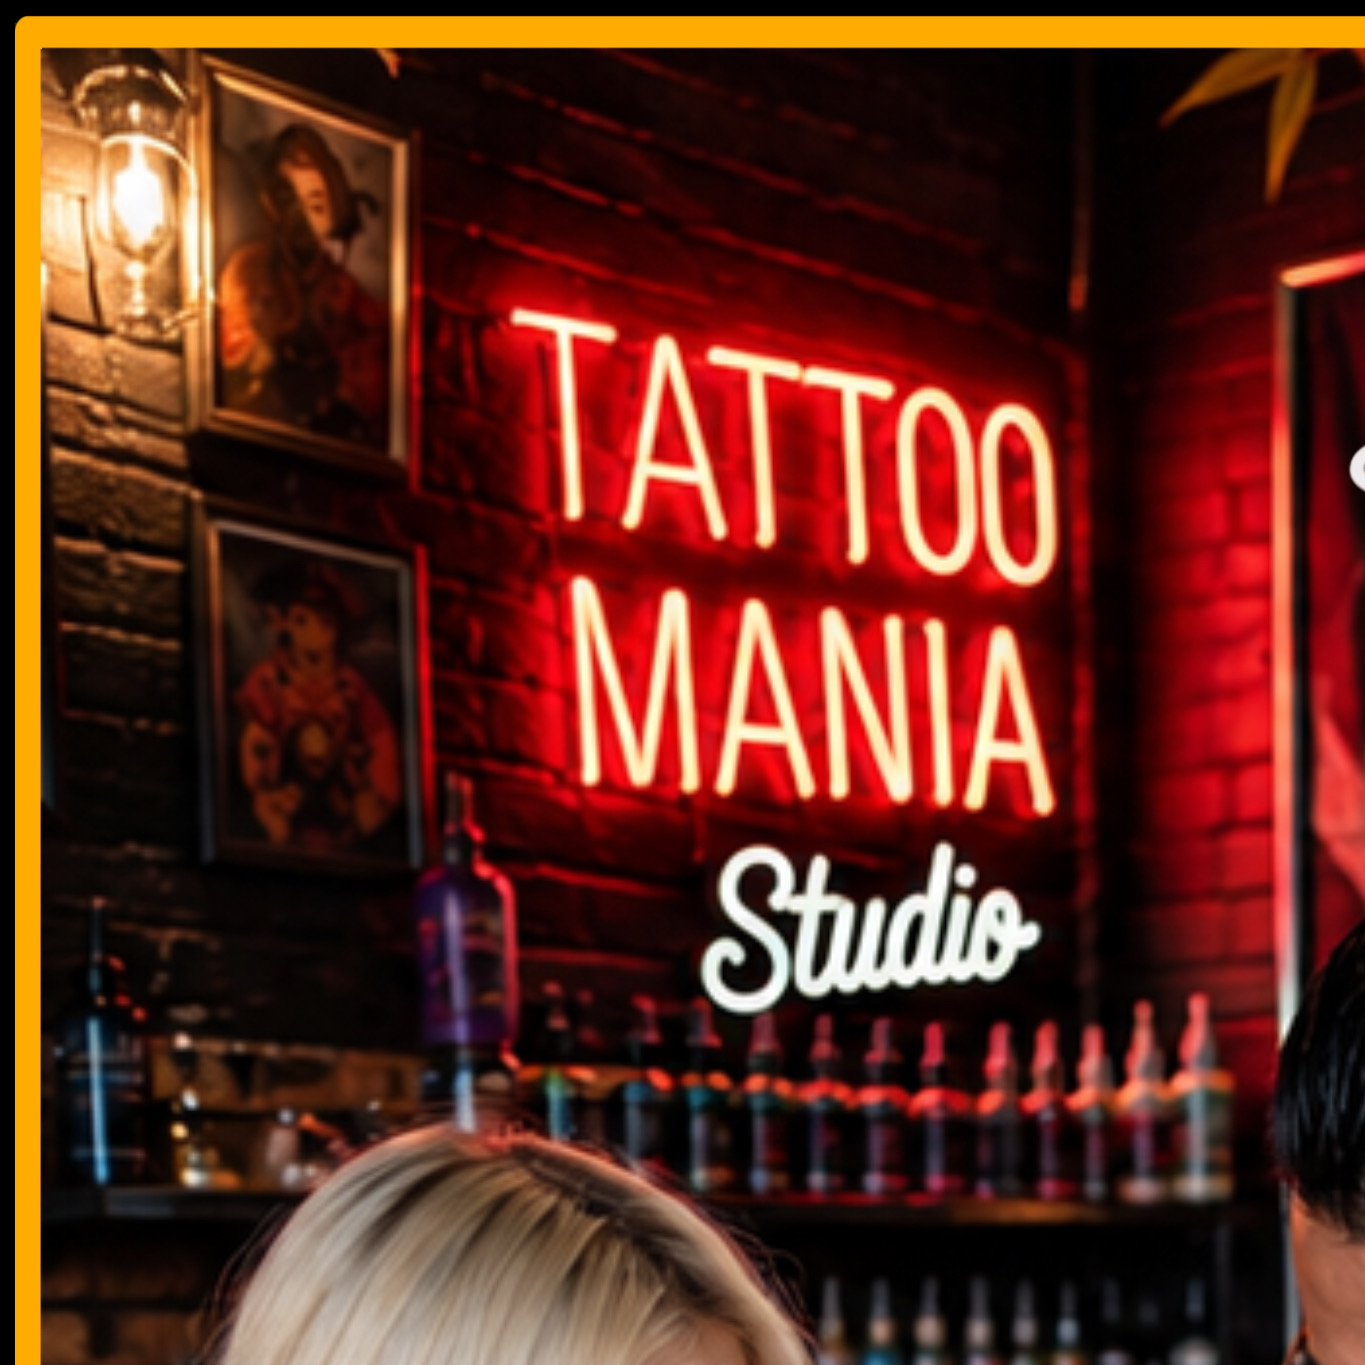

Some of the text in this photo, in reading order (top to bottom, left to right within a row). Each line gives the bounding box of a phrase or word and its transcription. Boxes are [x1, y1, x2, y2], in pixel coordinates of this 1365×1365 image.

[510, 307, 1057, 587] TATTOO
[571, 575, 1055, 816] MANIA
[700, 842, 1041, 1014] Studio
